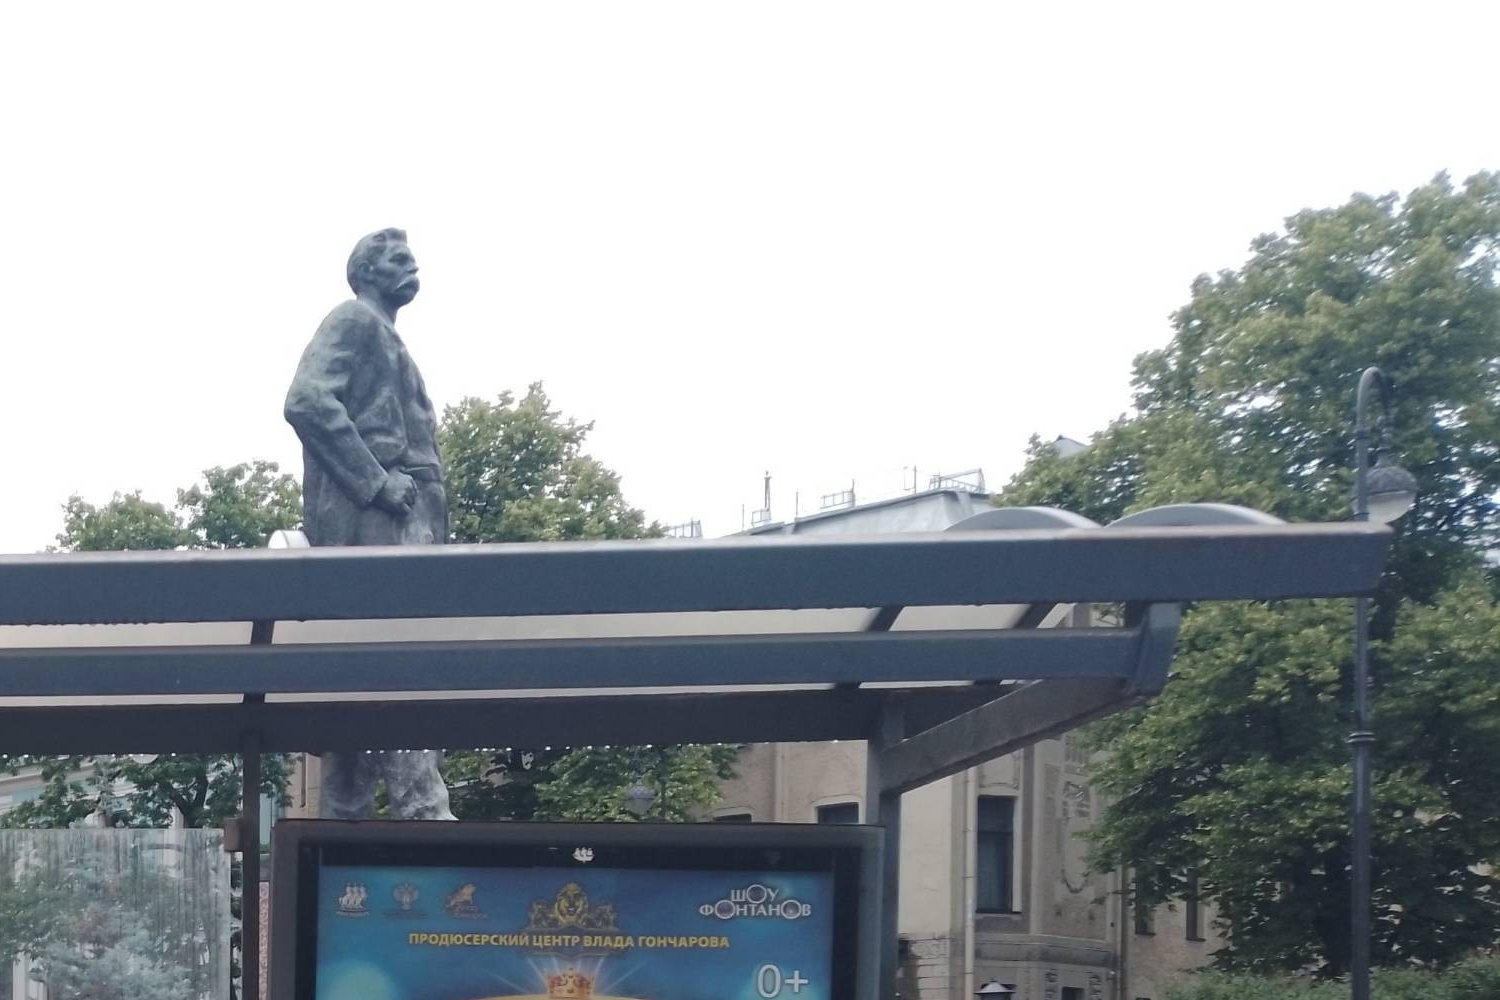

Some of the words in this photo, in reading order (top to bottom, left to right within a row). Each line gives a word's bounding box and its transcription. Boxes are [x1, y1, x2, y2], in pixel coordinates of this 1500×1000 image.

[730, 884, 779, 904] ШОУ
[699, 899, 812, 919] ФОНТАНОВ
[408, 931, 530, 948] ПРОДЮСЕРСКИЙ
[531, 934, 581, 949] ЦЕНТР
[583, 935, 634, 949] ВЛАДА
[637, 935, 731, 949] ГОНЧАРОВА
[757, 963, 810, 999] 0+
